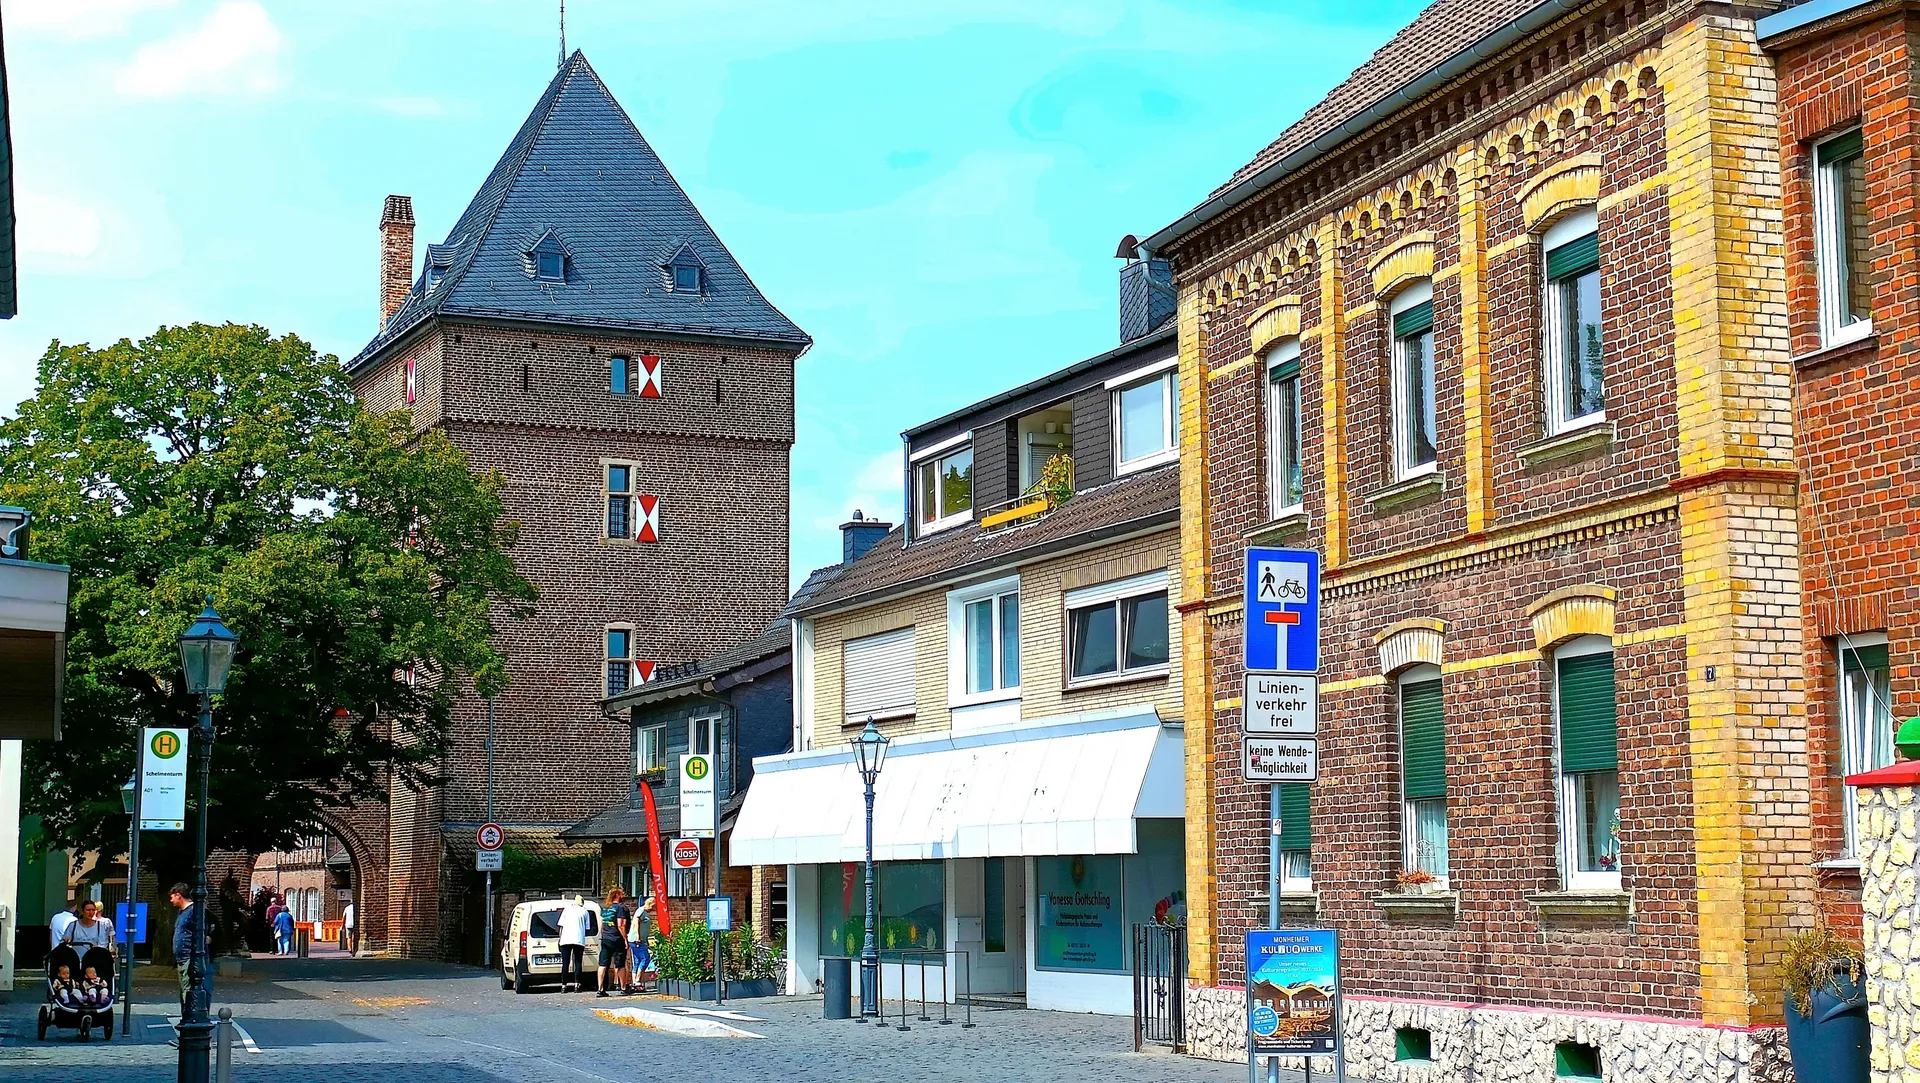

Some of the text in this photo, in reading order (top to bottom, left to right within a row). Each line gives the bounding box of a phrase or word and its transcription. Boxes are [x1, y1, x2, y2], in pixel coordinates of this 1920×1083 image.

[1707, 667, 1713, 679] 7
[1258, 680, 1305, 694] Linien-
[1255, 697, 1307, 711] verkehr
[1270, 714, 1293, 727] frei
[159, 736, 172, 753] H
[1249, 744, 1313, 757] keine Wende-
[692, 761, 702, 775] H
[675, 850, 698, 859] KIOSK
[1048, 891, 1111, 910] Vanessa Gottschling
[1260, 944, 1323, 955] KULTURWERKE
